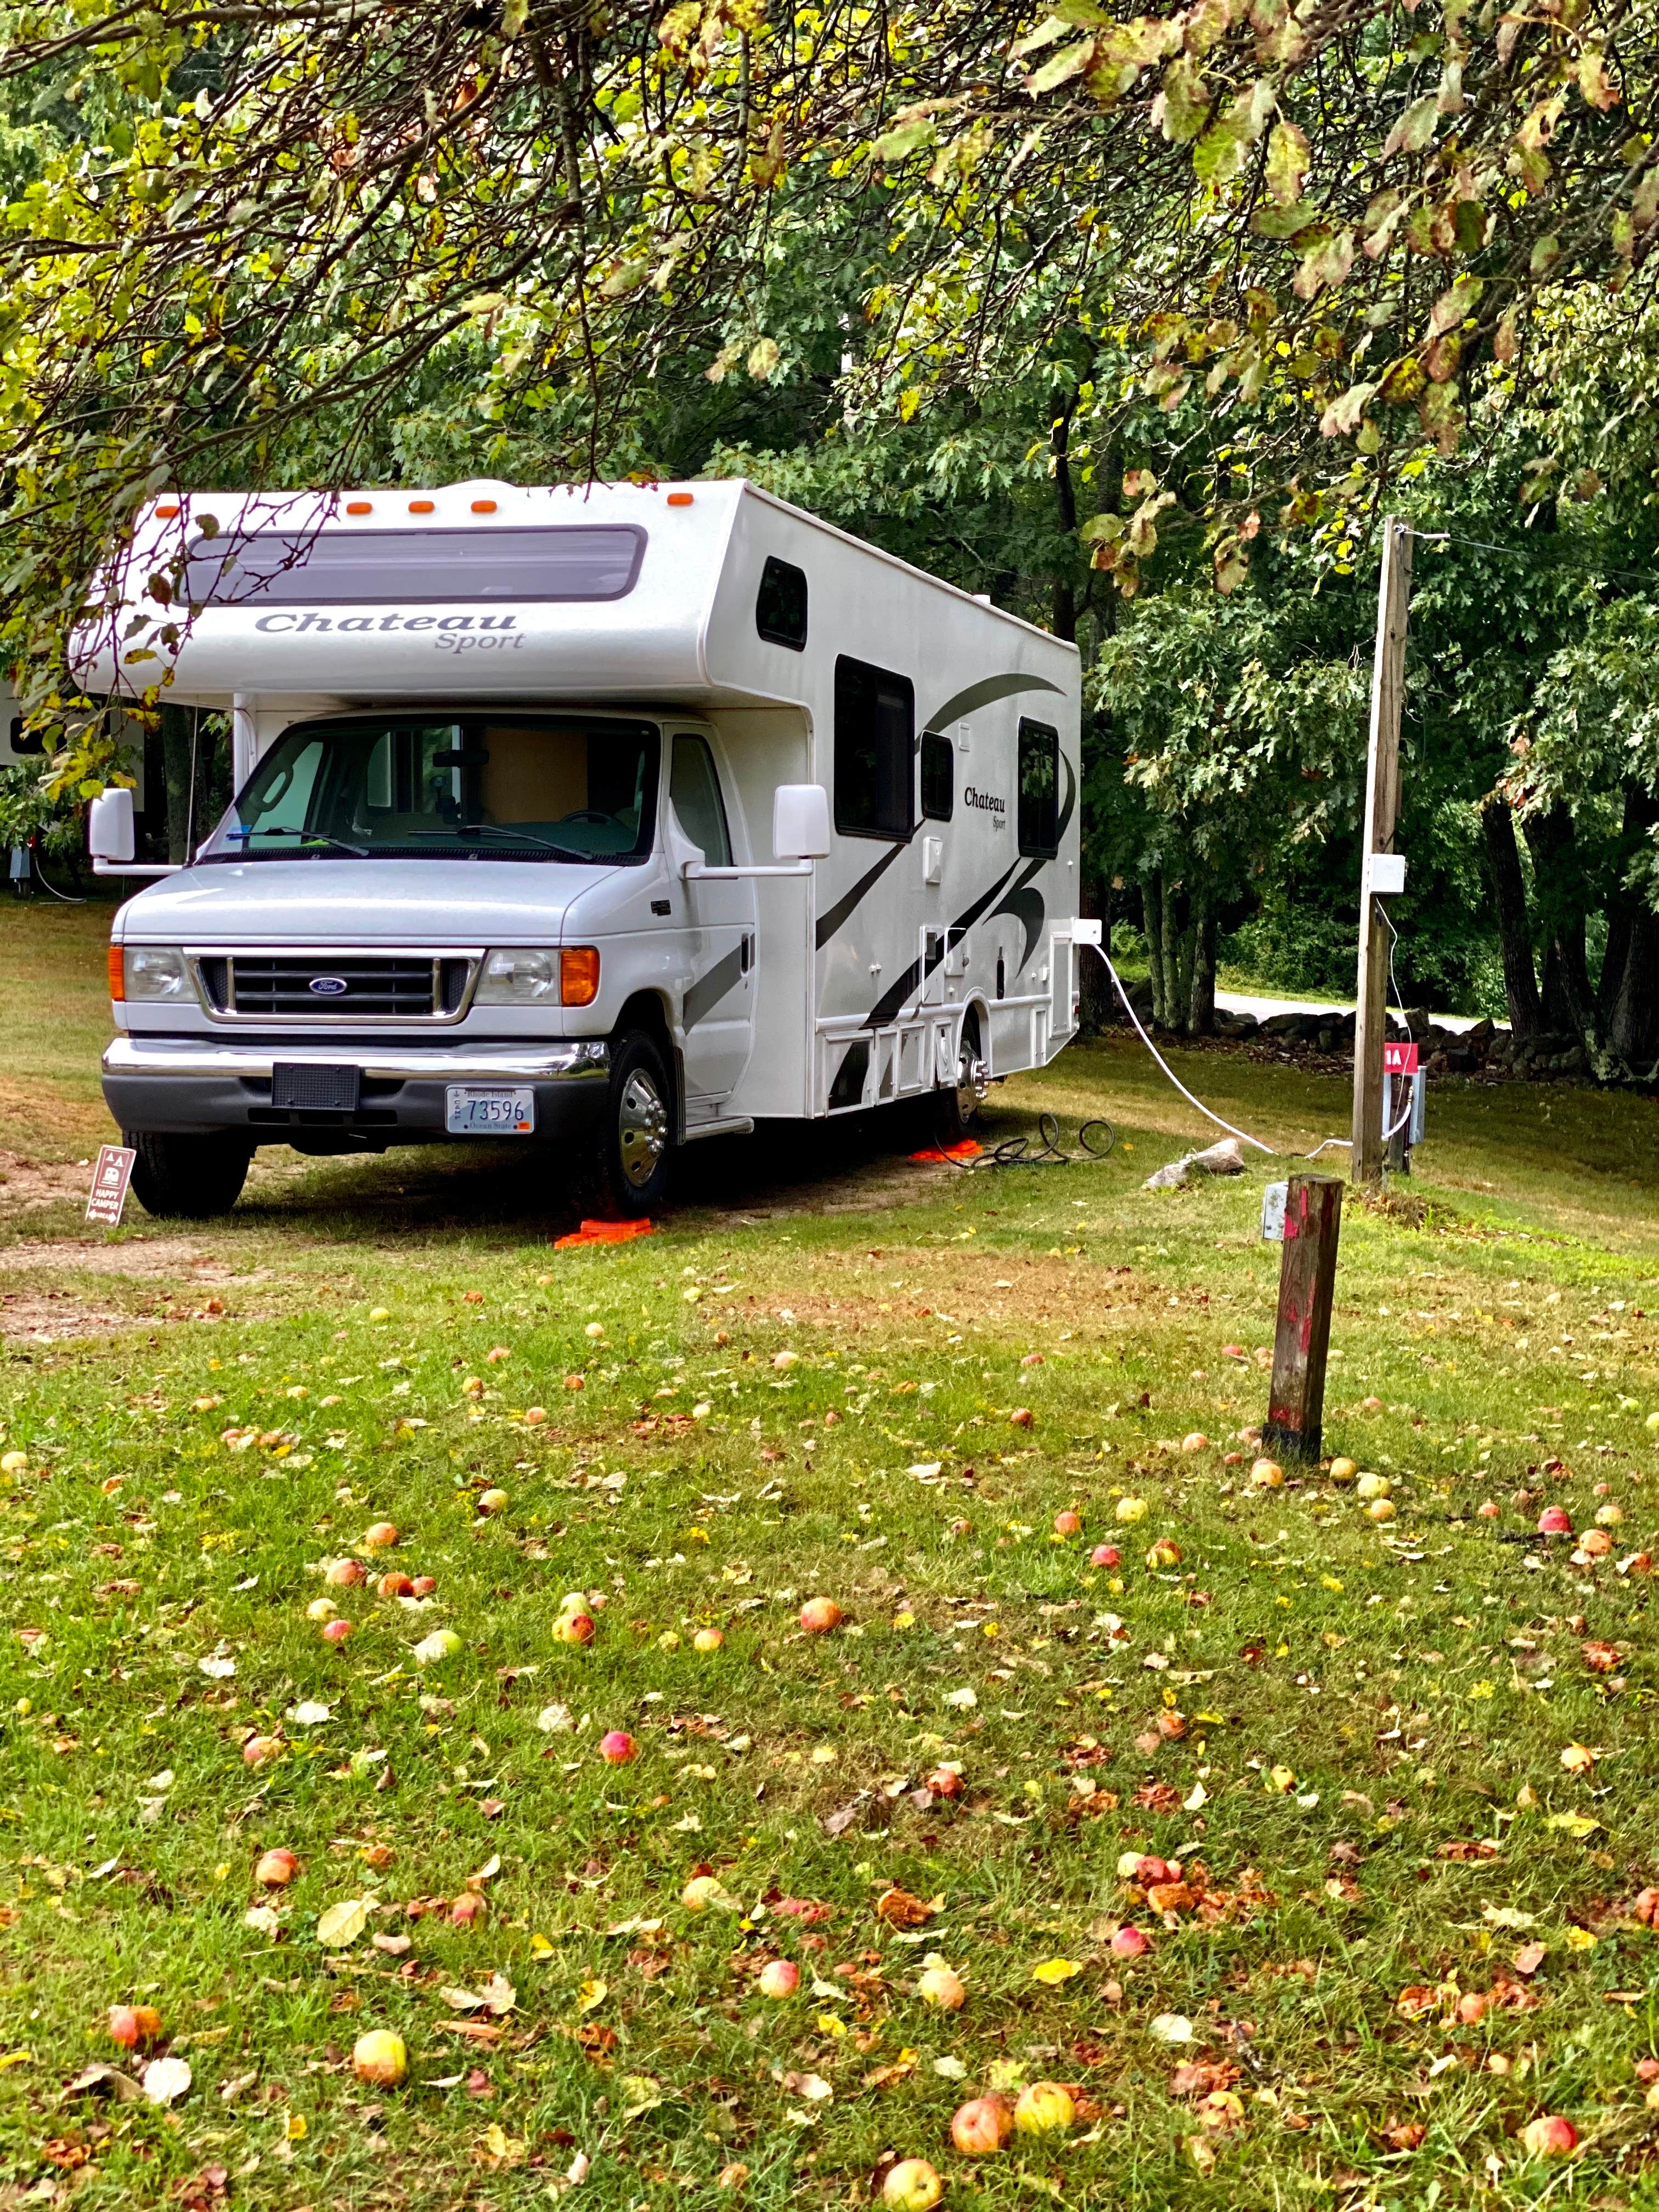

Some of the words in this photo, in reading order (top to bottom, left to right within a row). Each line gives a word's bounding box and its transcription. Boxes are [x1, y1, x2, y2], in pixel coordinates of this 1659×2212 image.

[255, 613, 517, 632] Chateau
[435, 633, 526, 653] Sport
[964, 787, 1005, 812] Chateau
[993, 815, 1006, 832] Sport
[318, 981, 337, 990] Ford
[1386, 1049, 1402, 1065] 1A
[467, 1101, 524, 1120] 73596
[96, 1188, 119, 1200] HAPPY
[92, 1198, 119, 1210] CAMPER
